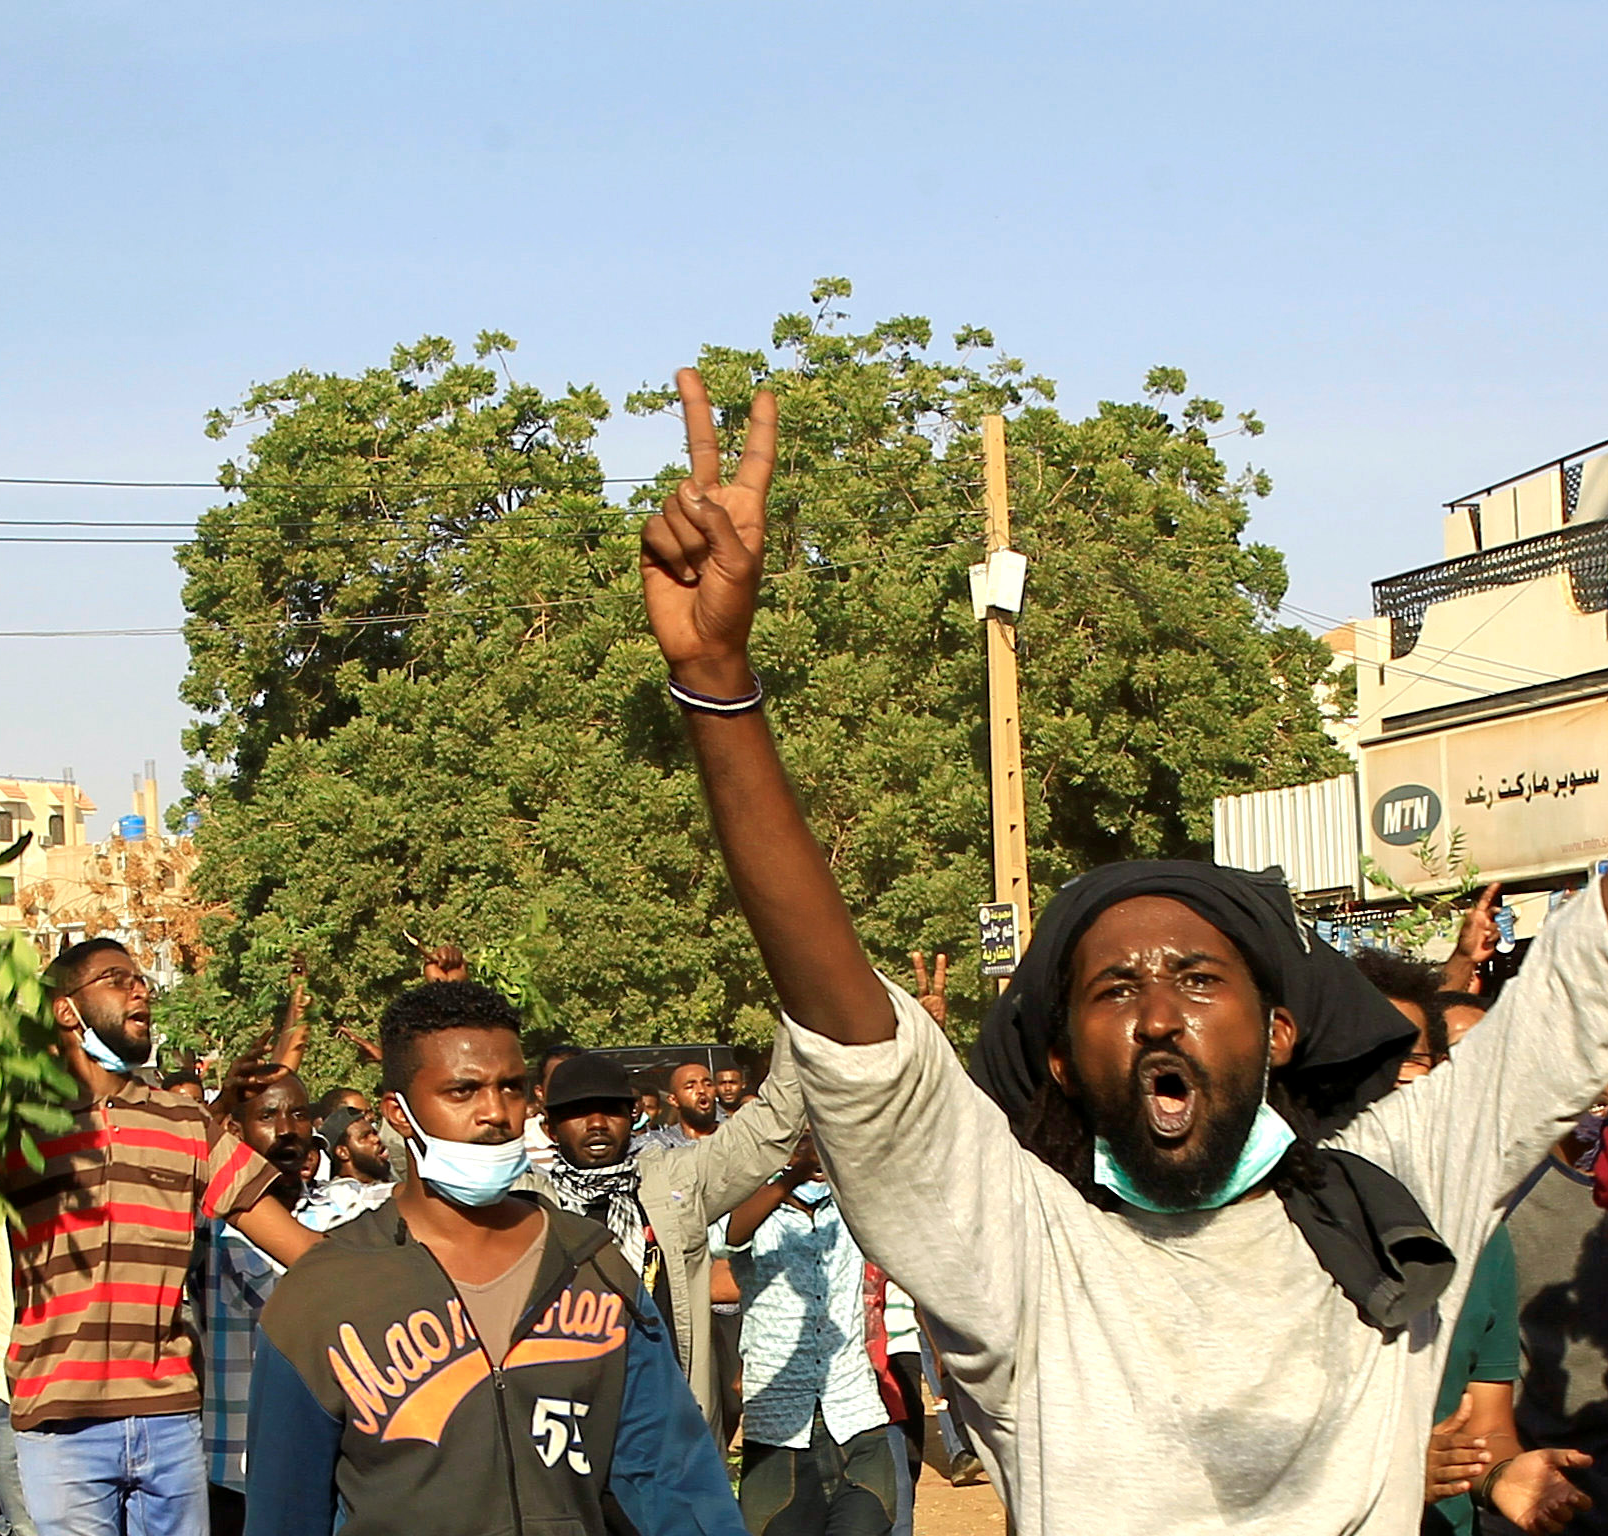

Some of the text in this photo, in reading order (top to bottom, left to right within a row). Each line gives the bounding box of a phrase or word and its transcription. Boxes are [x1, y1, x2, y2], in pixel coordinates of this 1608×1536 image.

[1464, 767, 1600, 810] سوبر ماركت رغد
[1382, 794, 1430, 836] MTN
